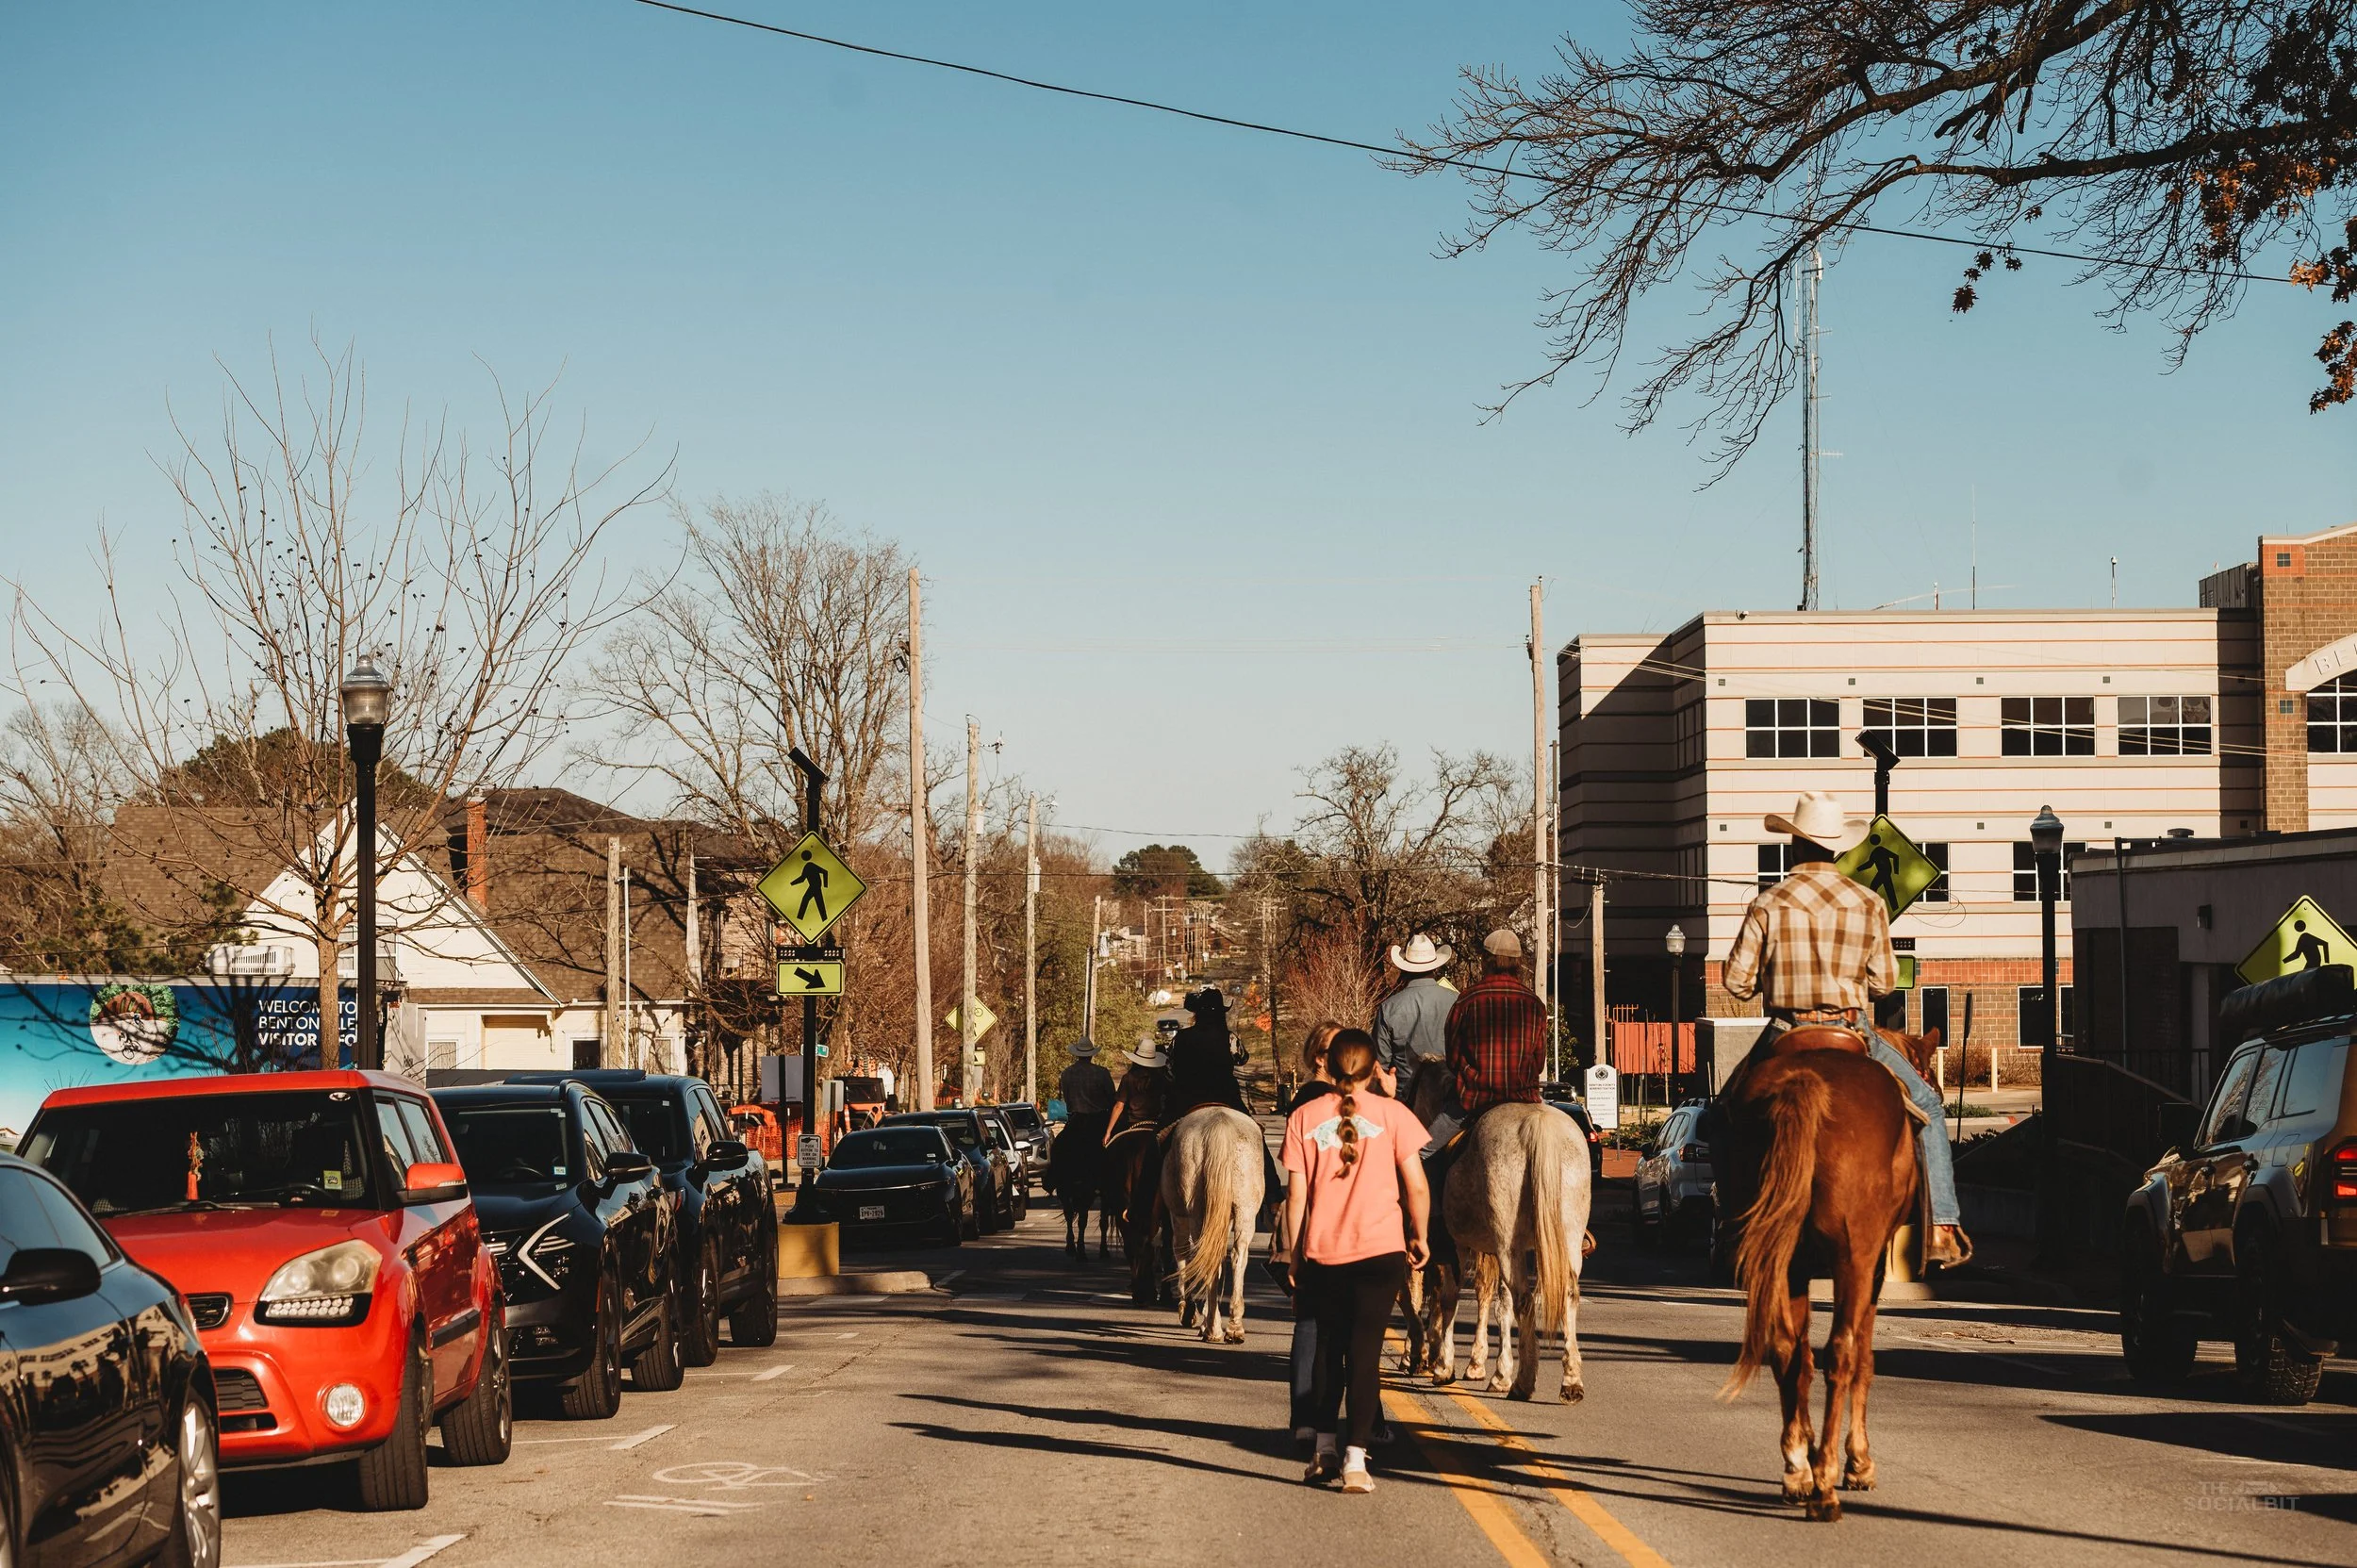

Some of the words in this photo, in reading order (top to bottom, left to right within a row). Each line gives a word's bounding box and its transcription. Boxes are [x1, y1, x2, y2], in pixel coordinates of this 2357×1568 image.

[258, 1000, 321, 1014] WELCOM
[338, 1001, 356, 1015] TO
[258, 1016, 355, 1031] BENTONLE
[258, 1032, 317, 1046] VISITOR
